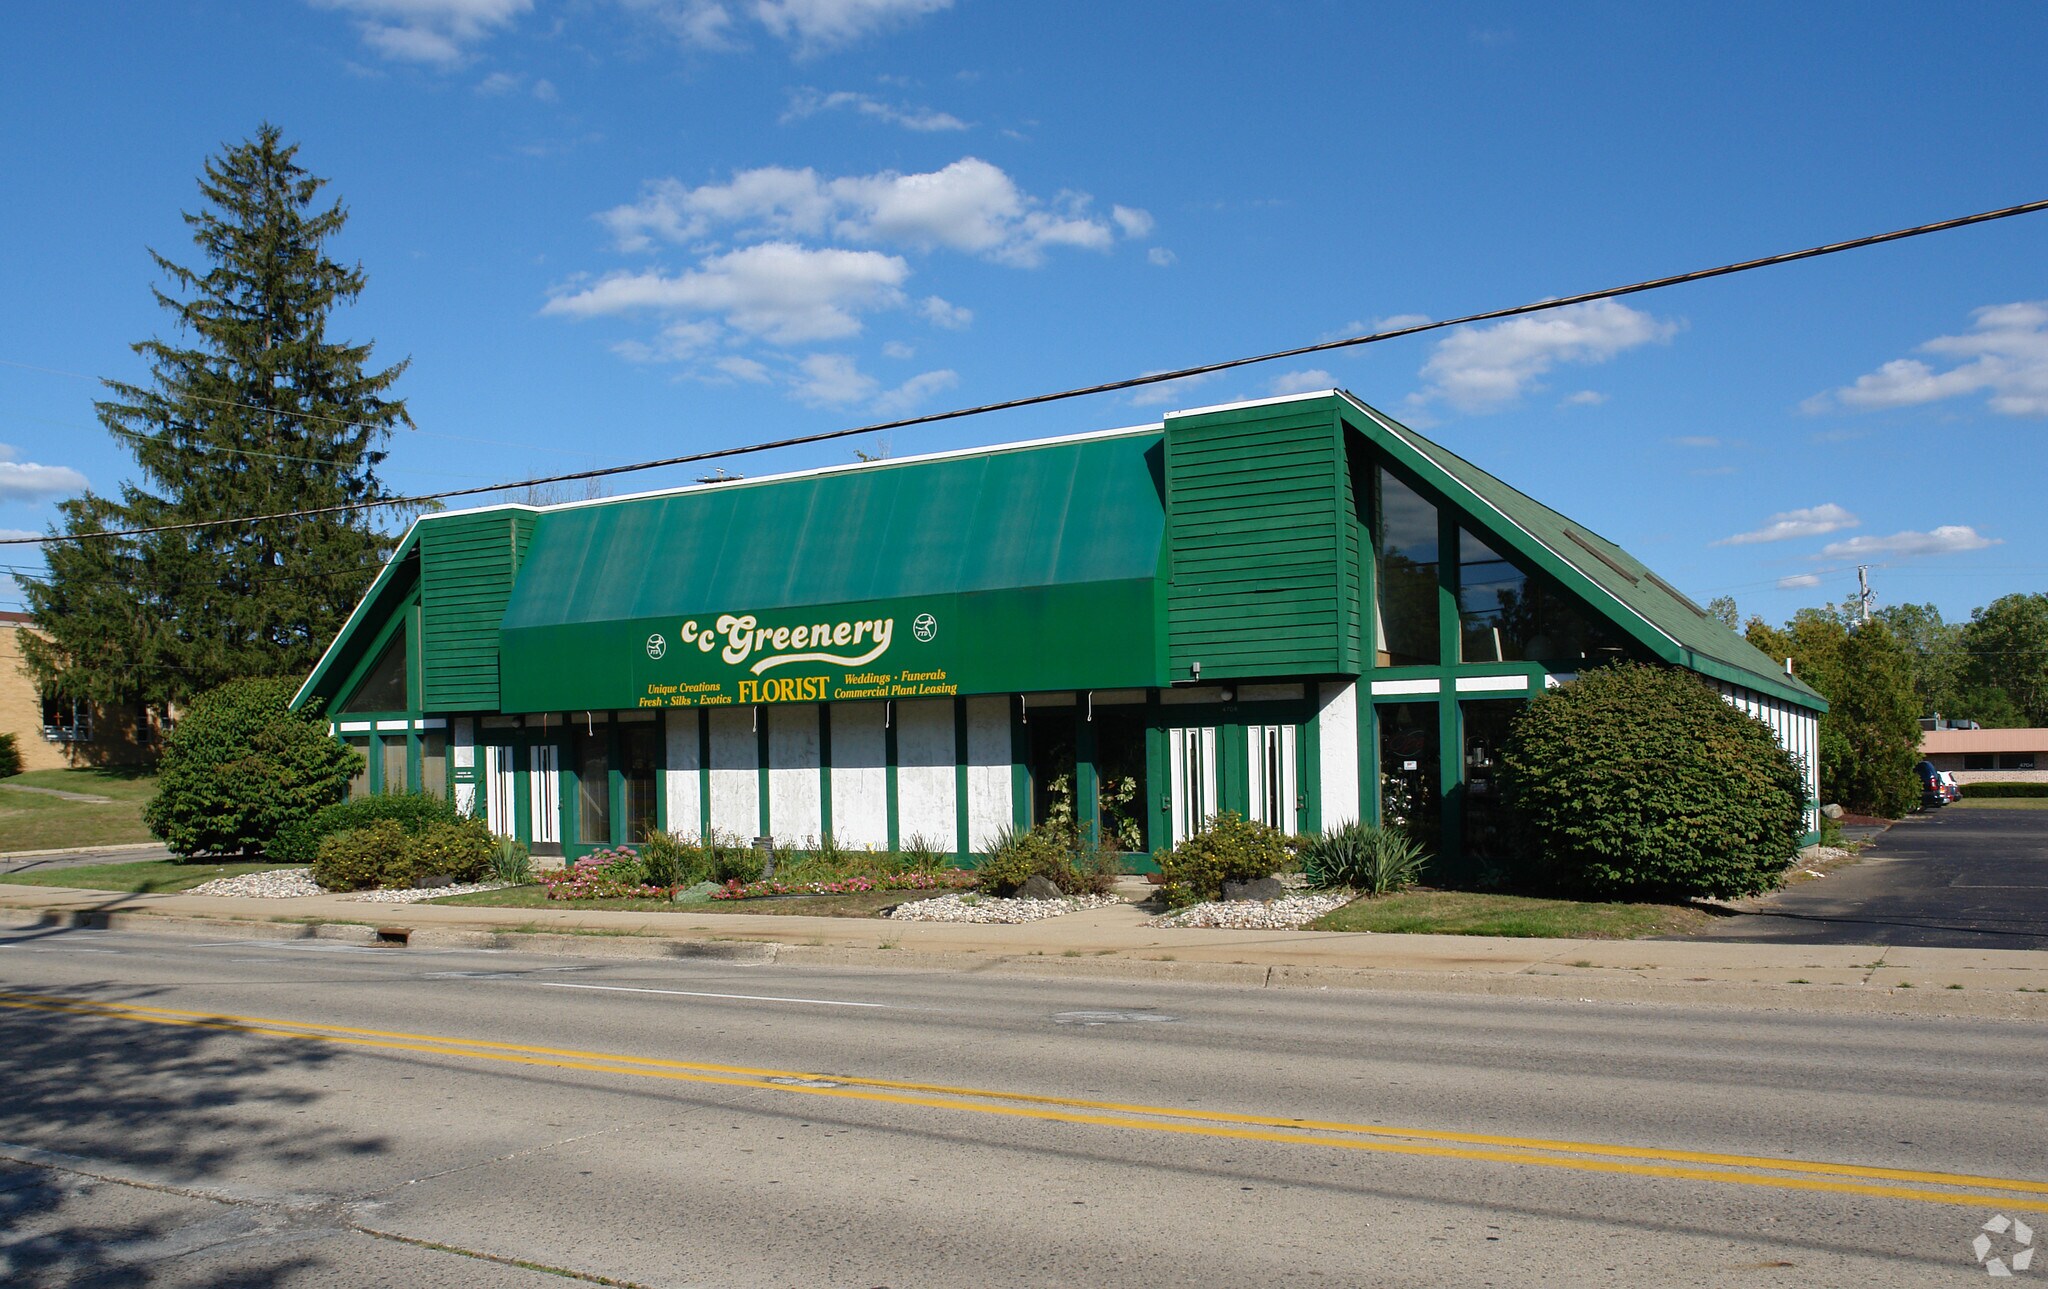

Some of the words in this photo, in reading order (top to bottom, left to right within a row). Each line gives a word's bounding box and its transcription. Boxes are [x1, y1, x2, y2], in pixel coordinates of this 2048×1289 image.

[716, 614, 894, 676] Greenery
[844, 673, 891, 685] Weddings
[901, 669, 947, 682] Funerals
[647, 684, 678, 696] Unique
[679, 682, 721, 693] Creations
[738, 676, 830, 703] FLORIST
[834, 686, 889, 699] Commercial
[891, 684, 916, 696] Plant
[918, 682, 958, 695] Leasing
[639, 697, 662, 707] Fresh
[670, 695, 692, 706] Silks
[700, 694, 732, 705] Exotics
